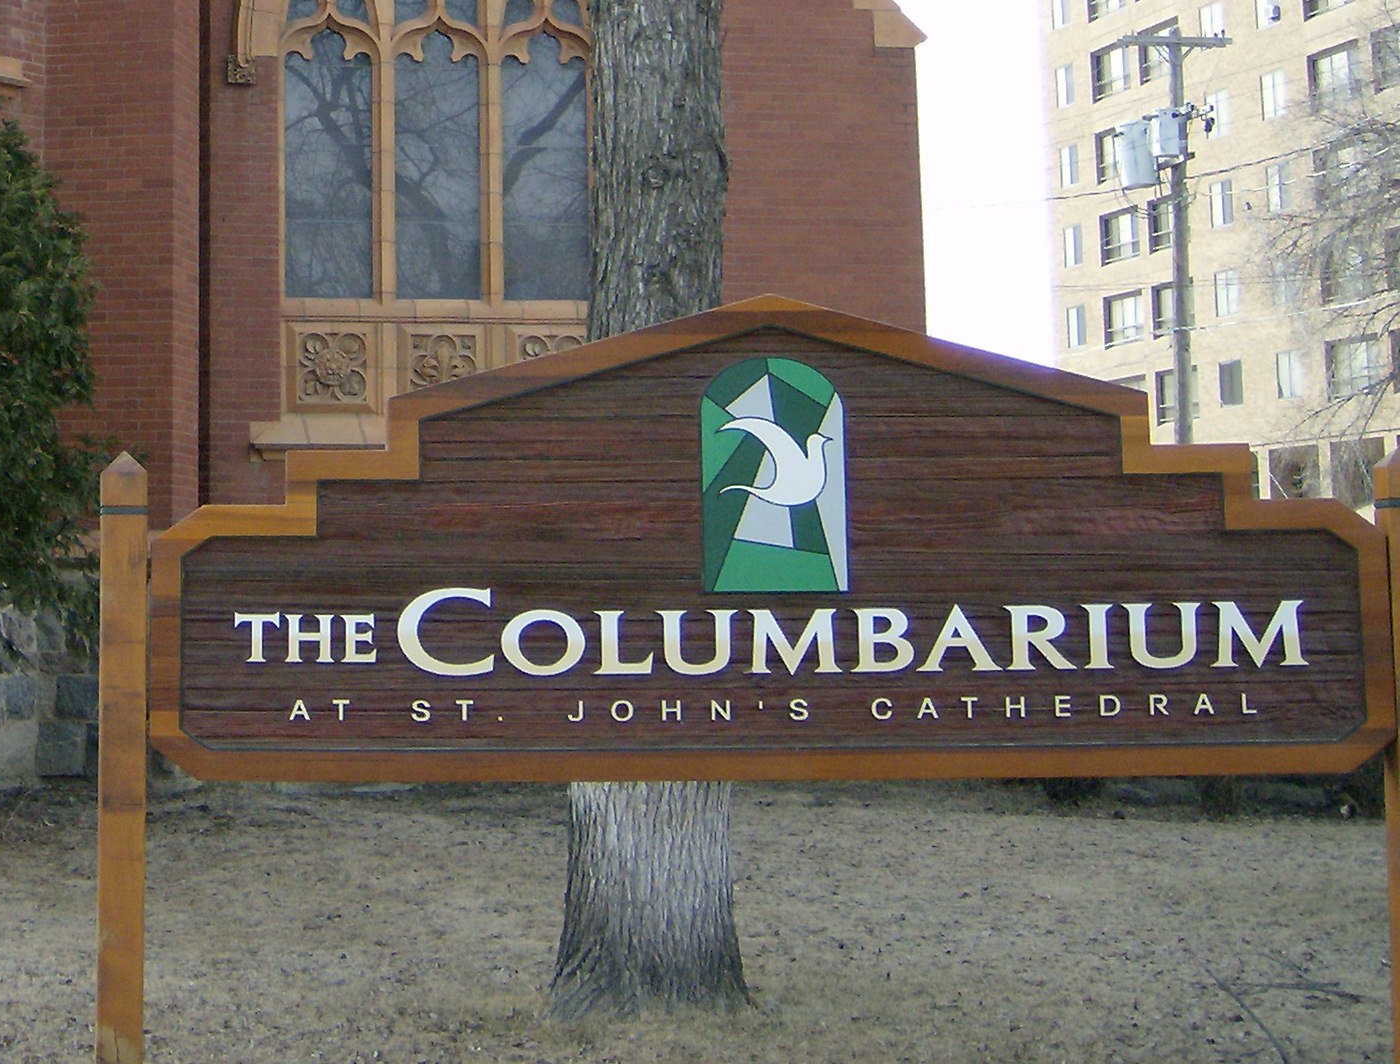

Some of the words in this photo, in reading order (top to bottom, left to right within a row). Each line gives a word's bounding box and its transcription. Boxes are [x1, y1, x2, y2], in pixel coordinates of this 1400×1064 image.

[234, 611, 377, 664] THE
[396, 587, 1309, 676] COLUMBARIUM
[289, 699, 350, 721] AT
[411, 700, 503, 722] ST.
[567, 698, 809, 722] JOHN'S
[871, 693, 1258, 720] CATHEDRAL
